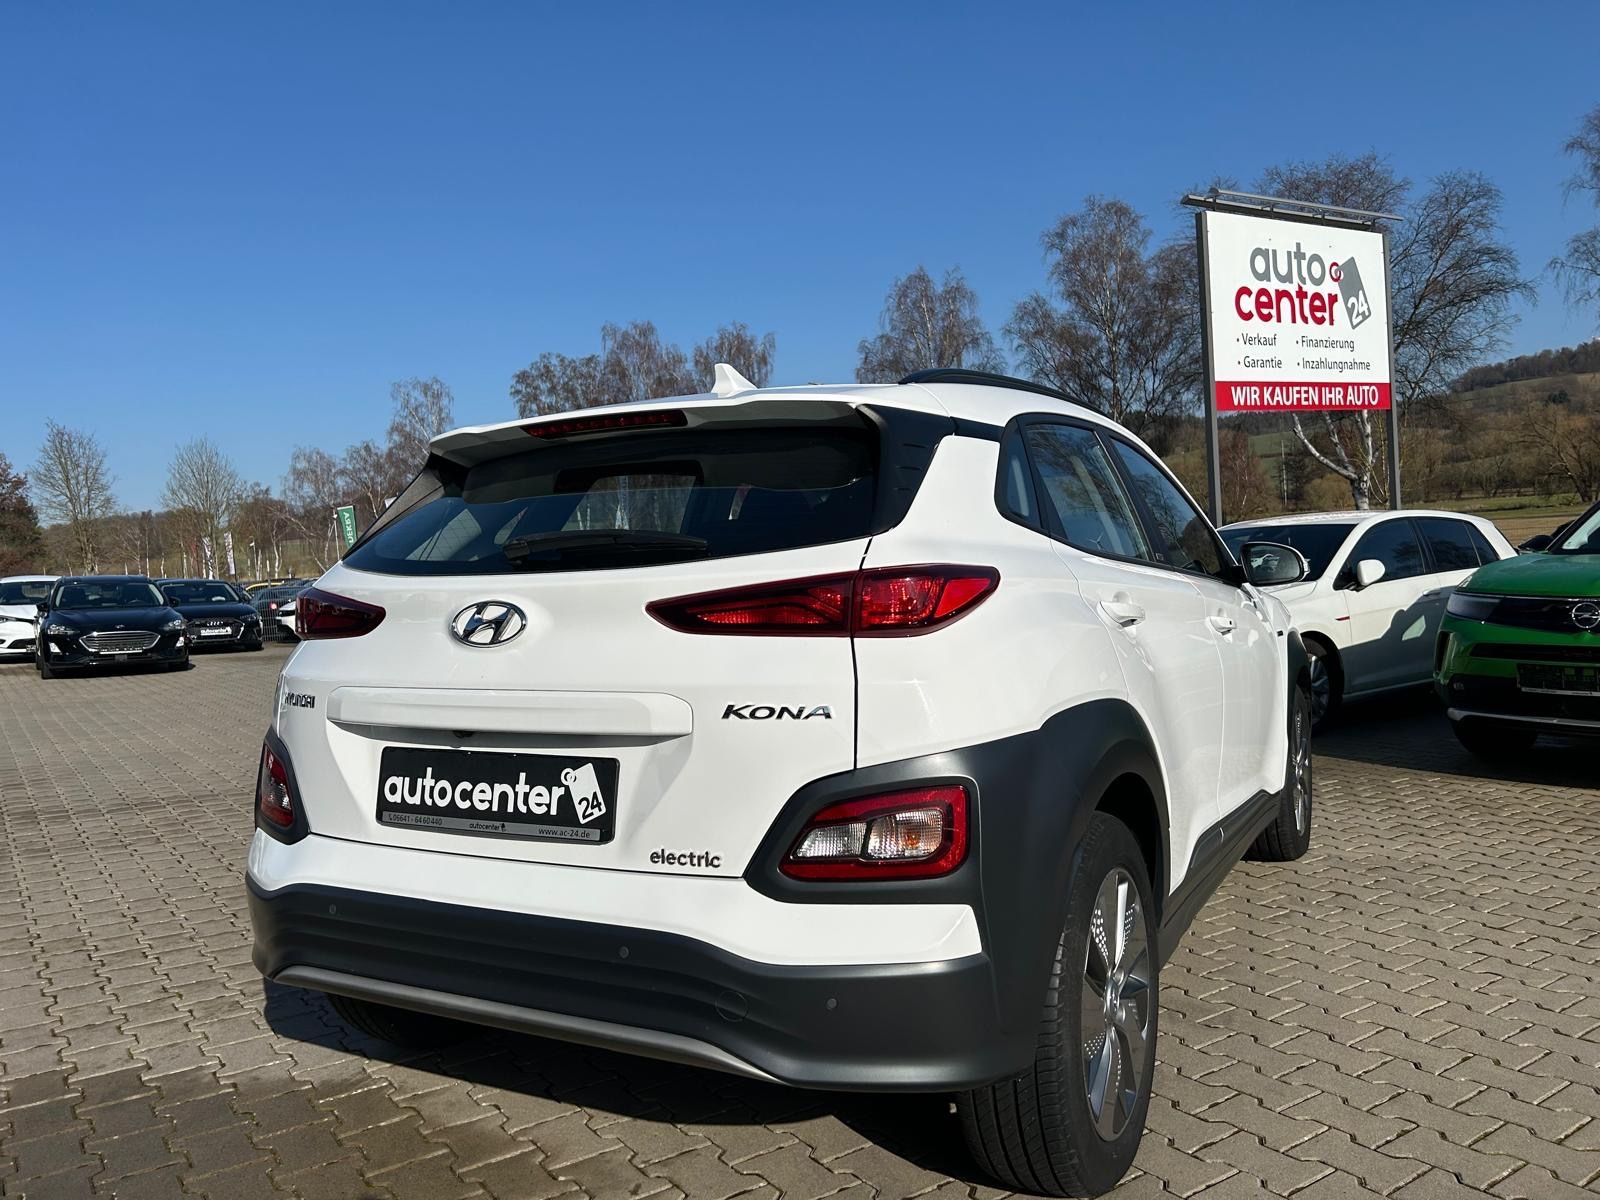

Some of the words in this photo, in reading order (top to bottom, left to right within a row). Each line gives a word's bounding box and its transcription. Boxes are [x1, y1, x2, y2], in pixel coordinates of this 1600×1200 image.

[1249, 242, 1326, 287] auto
[1234, 282, 1339, 326] center
[1347, 290, 1369, 323] 24
[1241, 333, 1277, 347] Verkauf
[1301, 335, 1355, 352] Finanzierung
[1243, 355, 1283, 369] Garantie
[1302, 357, 1371, 373] Inzahlungnahme
[1231, 386, 1260, 406] WIR
[1263, 386, 1319, 406] KAUFEN
[1321, 387, 1344, 405] IHR
[1346, 385, 1379, 406] AUTO
[285, 692, 315, 709] HYUNDAI
[721, 704, 833, 720] KONA
[577, 795, 603, 820] 24
[538, 827, 591, 839] www.ac-24.de
[650, 848, 721, 868] electric
